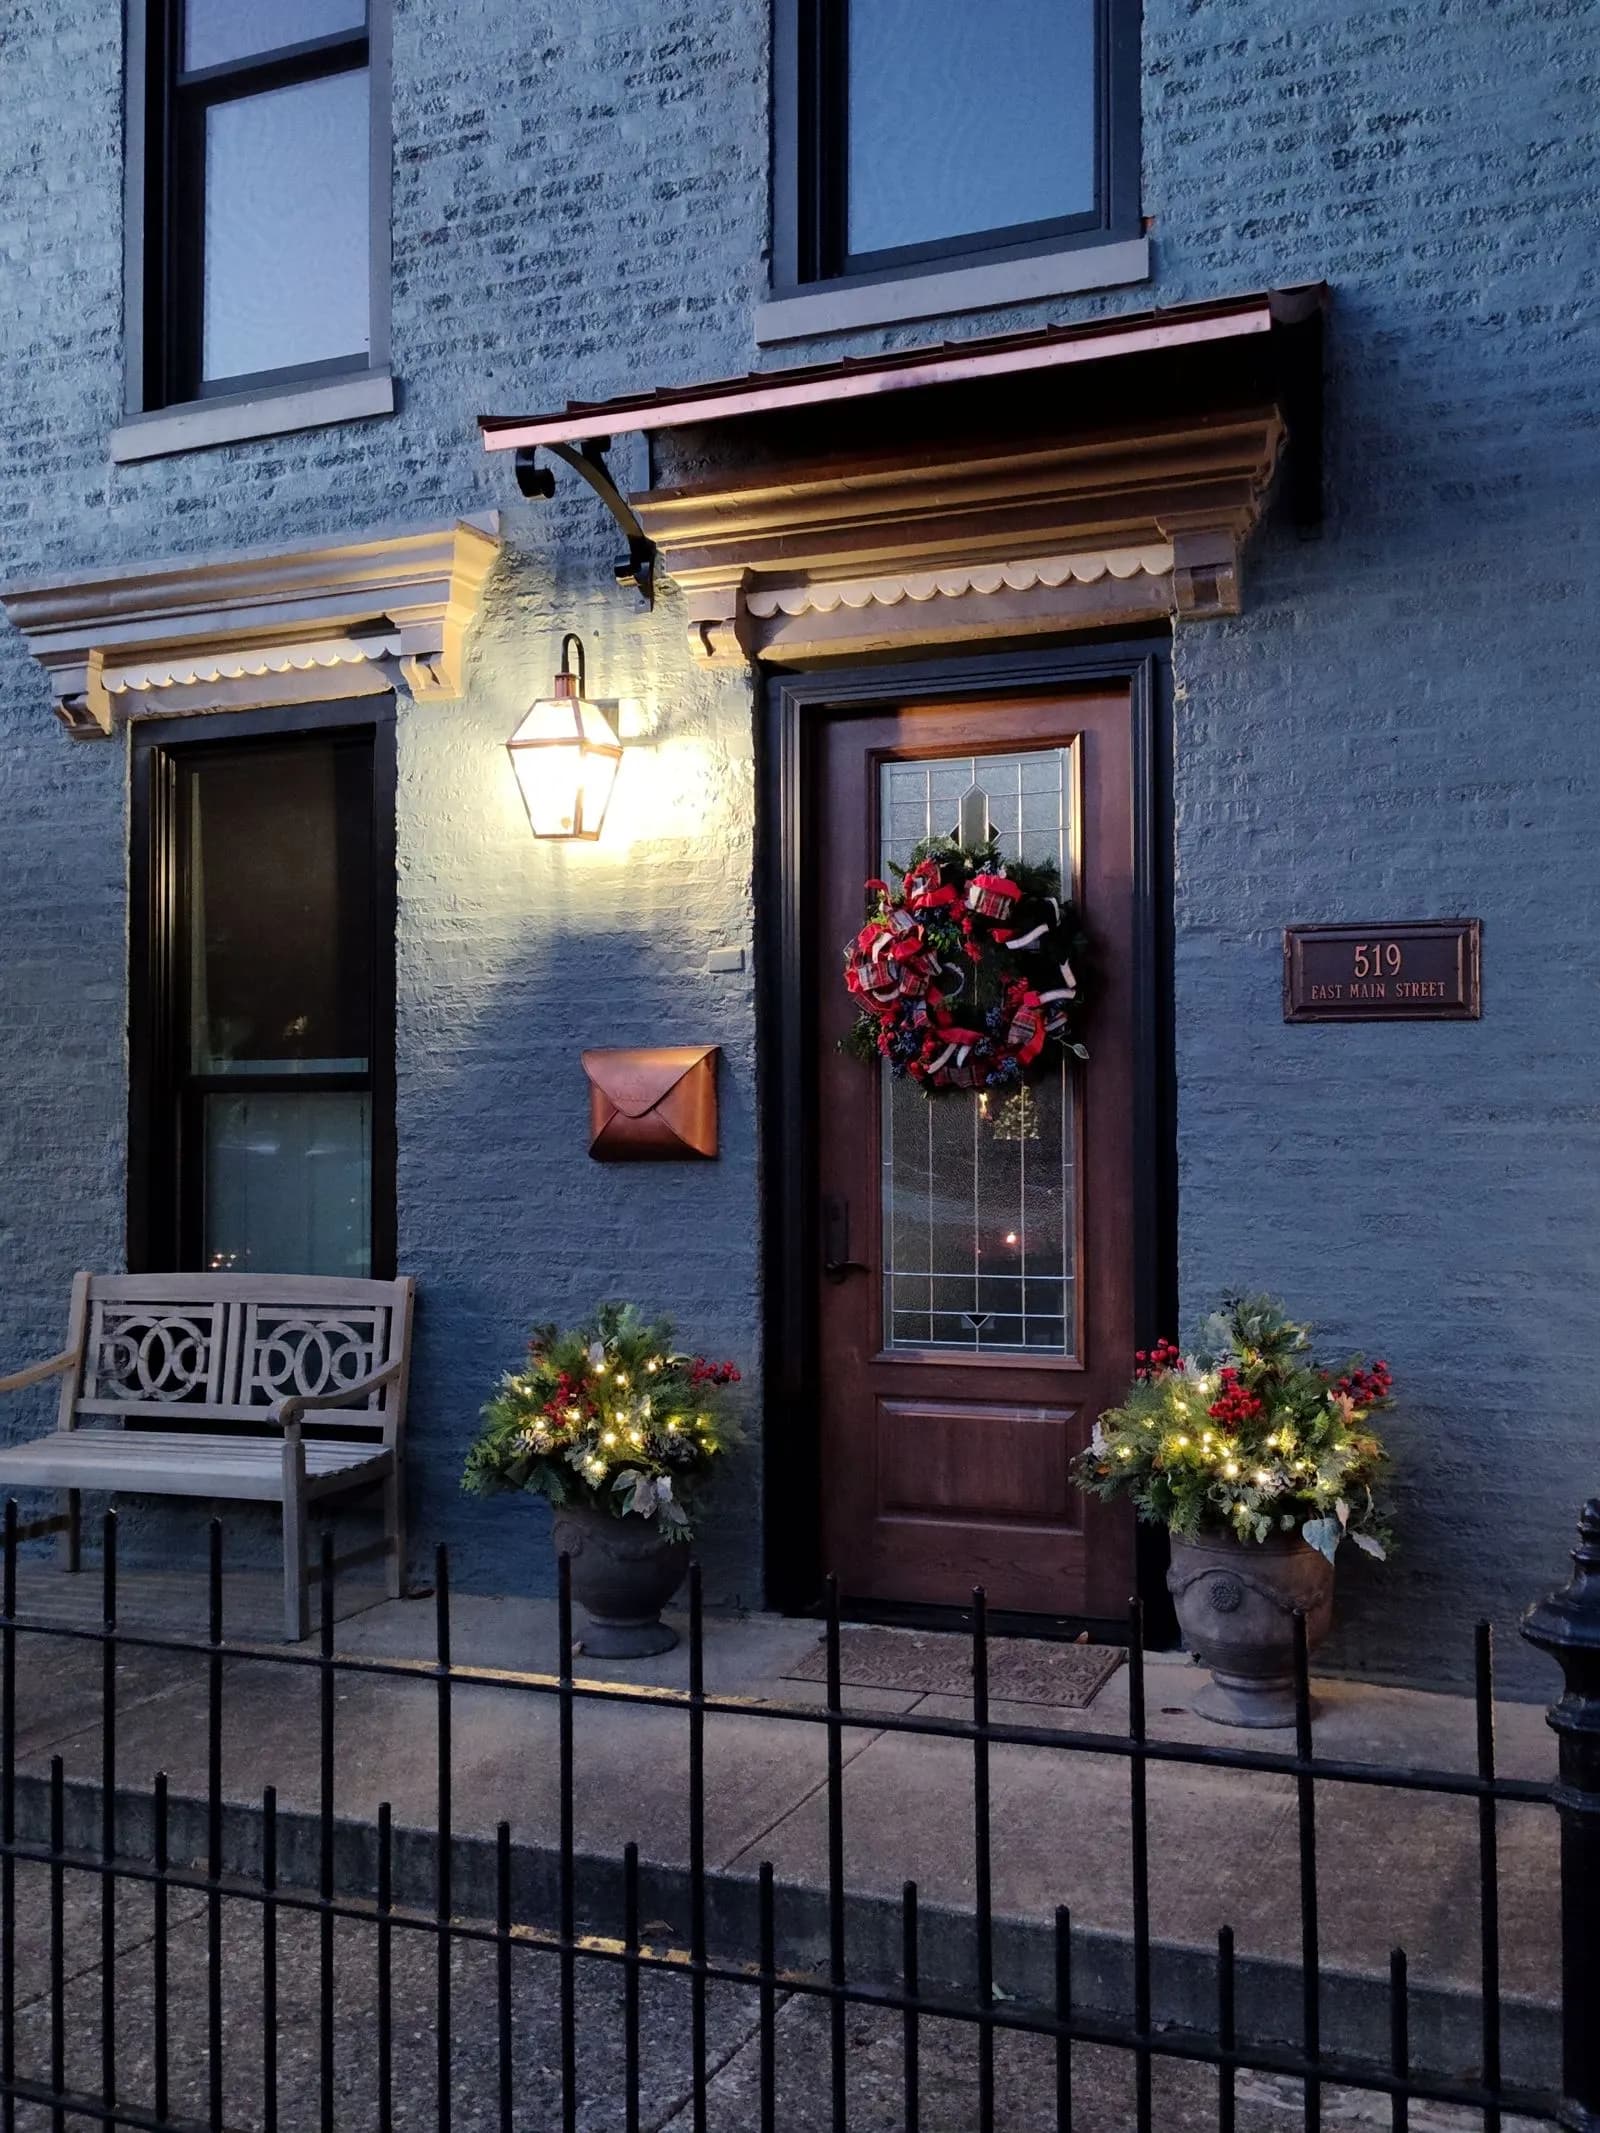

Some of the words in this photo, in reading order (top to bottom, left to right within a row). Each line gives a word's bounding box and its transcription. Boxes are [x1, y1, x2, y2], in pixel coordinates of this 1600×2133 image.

[1354, 943, 1401, 978] 519
[1311, 984, 1342, 1000] EAST
[1350, 983, 1385, 998] MAIN
[1396, 982, 1446, 997] STREET
